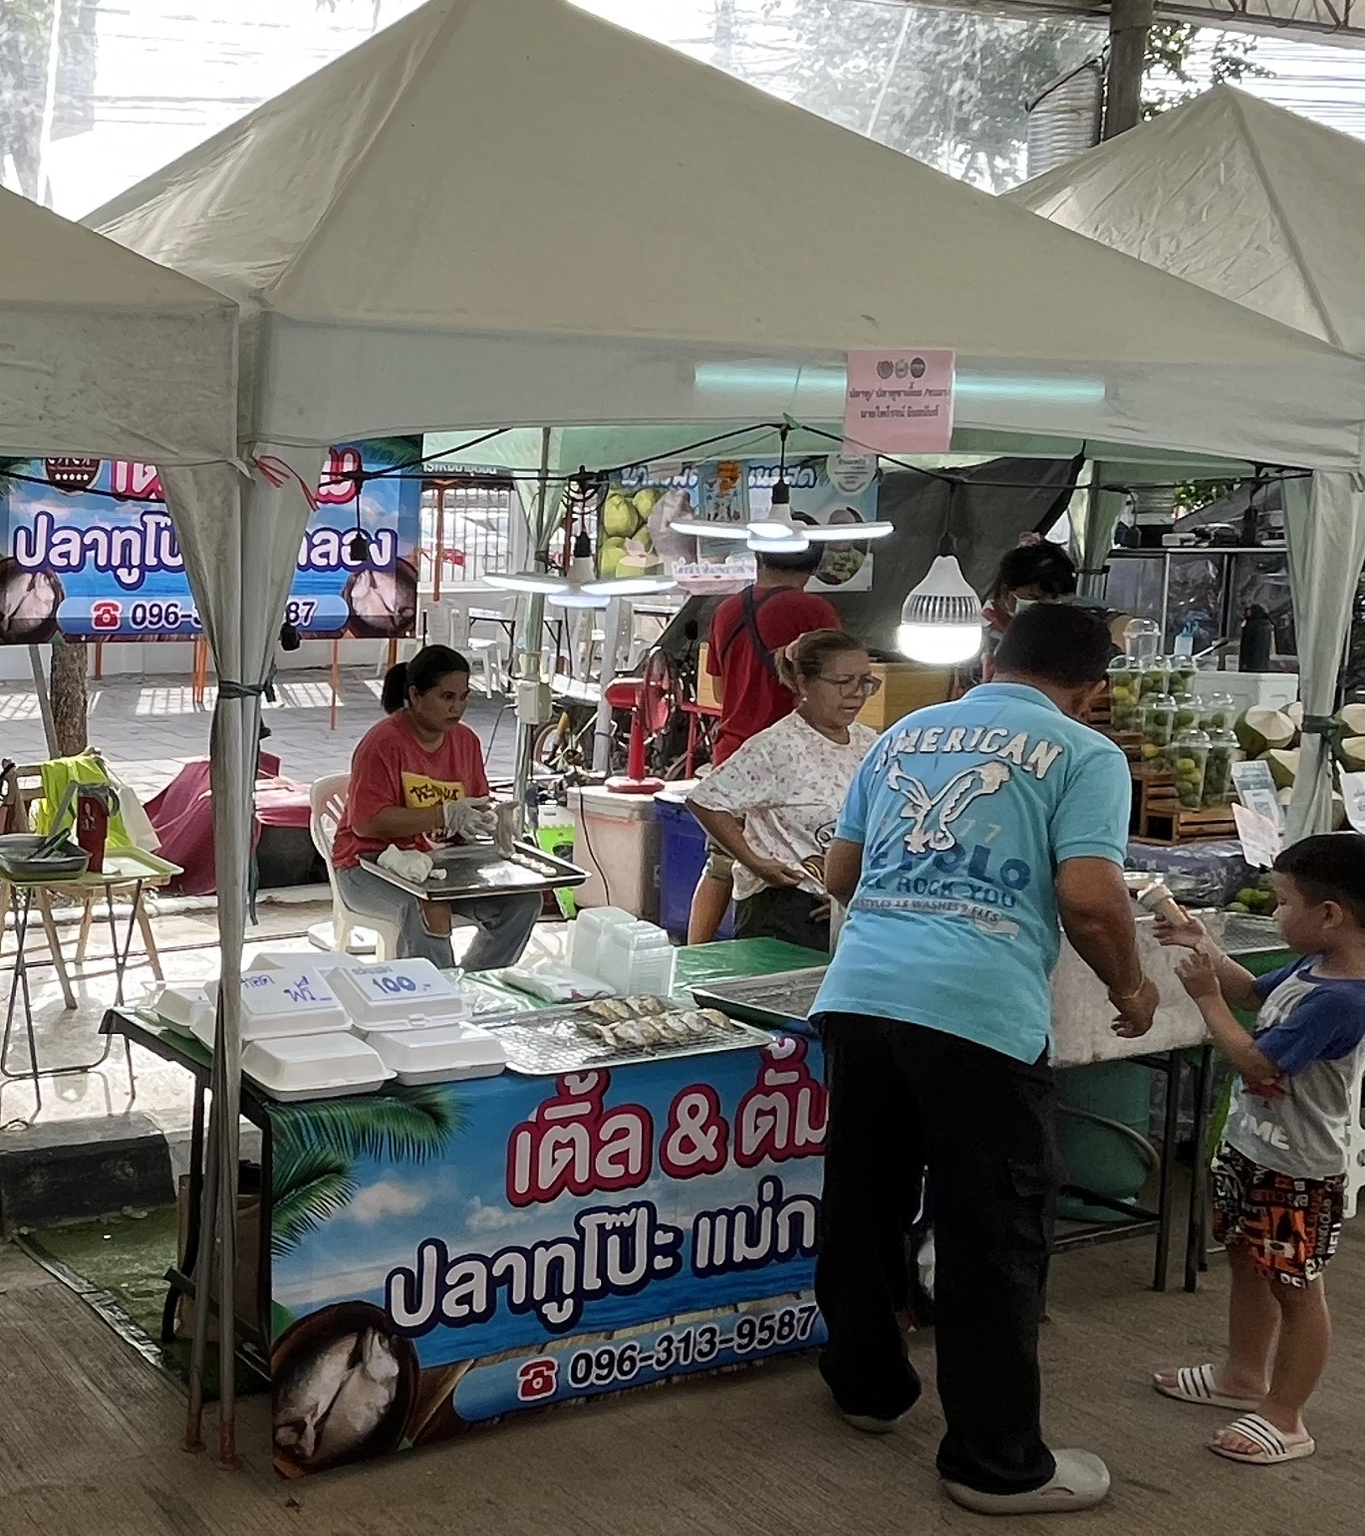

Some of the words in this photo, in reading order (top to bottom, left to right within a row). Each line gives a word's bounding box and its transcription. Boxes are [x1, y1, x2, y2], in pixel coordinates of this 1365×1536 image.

[16, 513, 183, 585] ปลาทูโป
[514, 1071, 644, 1195] เติ้ล
[667, 1092, 726, 1168] &
[390, 1207, 678, 1325] ปลาทูโป๊ะ
[696, 1181, 817, 1270] แม่ก
[569, 1306, 819, 1389] 096-313-9587
